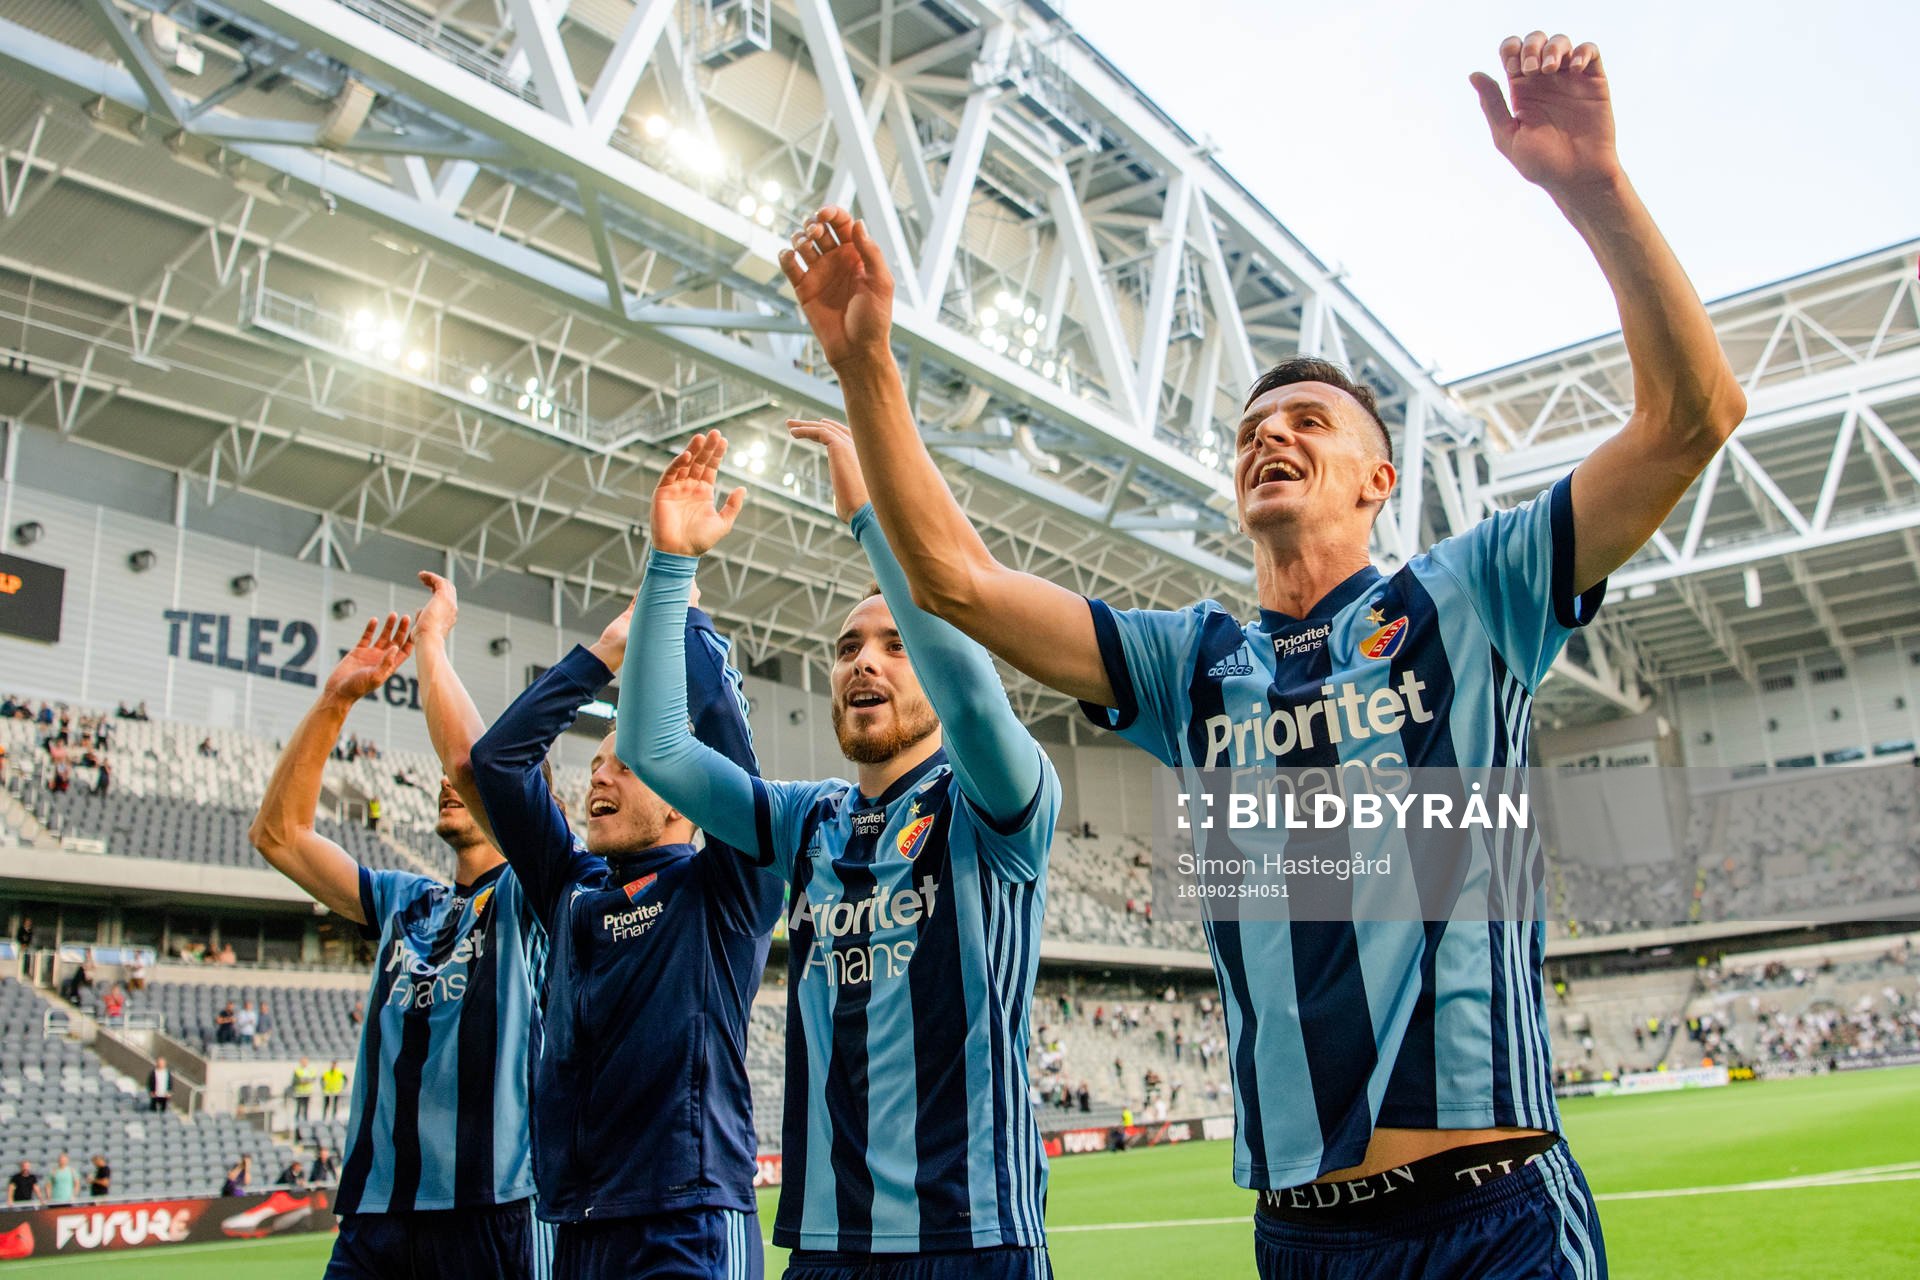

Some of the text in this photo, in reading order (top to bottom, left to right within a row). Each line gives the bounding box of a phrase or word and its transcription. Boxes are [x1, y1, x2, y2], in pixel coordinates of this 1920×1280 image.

[163, 609, 319, 688] TELE2
[1273, 624, 1330, 653] Prioritet
[1283, 639, 1322, 659] Finans
[1207, 664, 1254, 677] adidas
[1203, 670, 1434, 773] Prioritet
[1228, 752, 1409, 823] Finans
[851, 812, 886, 829] Prioritet
[603, 901, 664, 930] Prioritet
[788, 874, 940, 938] Prioritet
[1257, 1165, 1415, 1209] WEDEN
